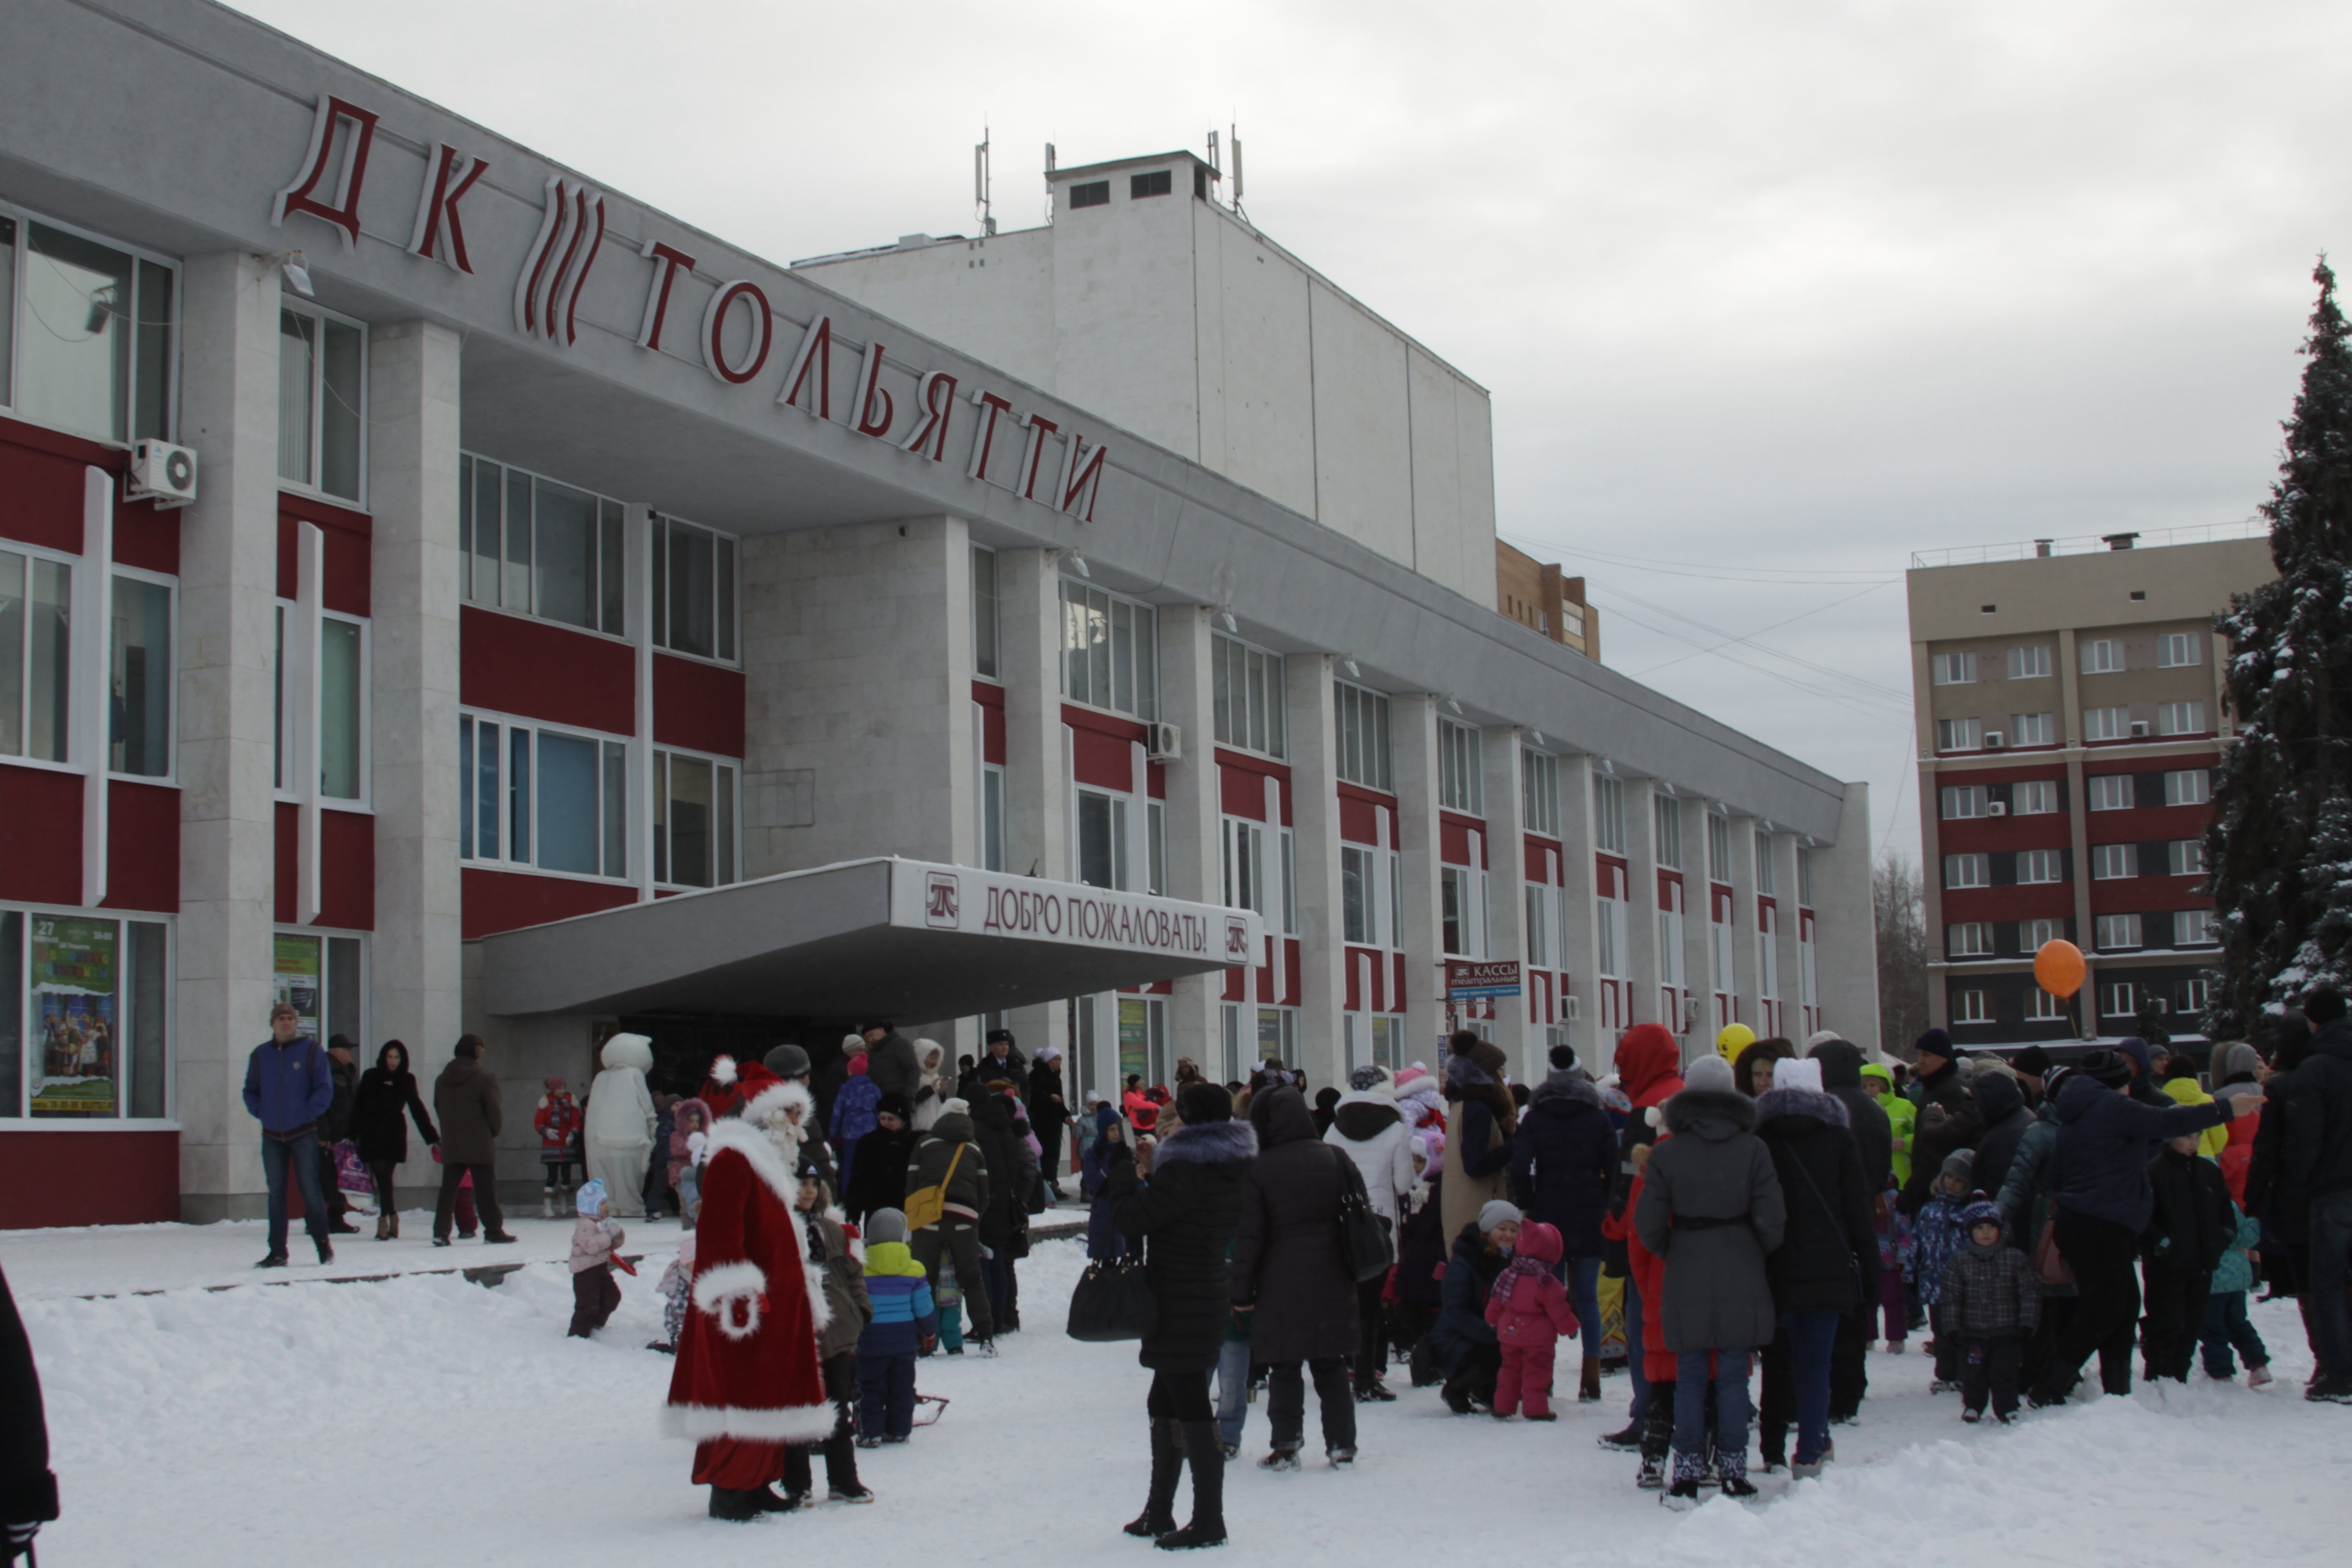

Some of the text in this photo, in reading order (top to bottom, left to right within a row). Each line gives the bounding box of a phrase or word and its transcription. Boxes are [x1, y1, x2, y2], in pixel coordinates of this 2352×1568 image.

[272, 94, 1107, 523] ДК ТОЛЬЯТТИ
[984, 886, 1207, 953] ДОБРО ПОЖАЛОВАТЬ!
[39, 921, 54, 935] 27
[1474, 964, 1518, 977] КАССЫ
[1451, 976, 1518, 986] театральные
